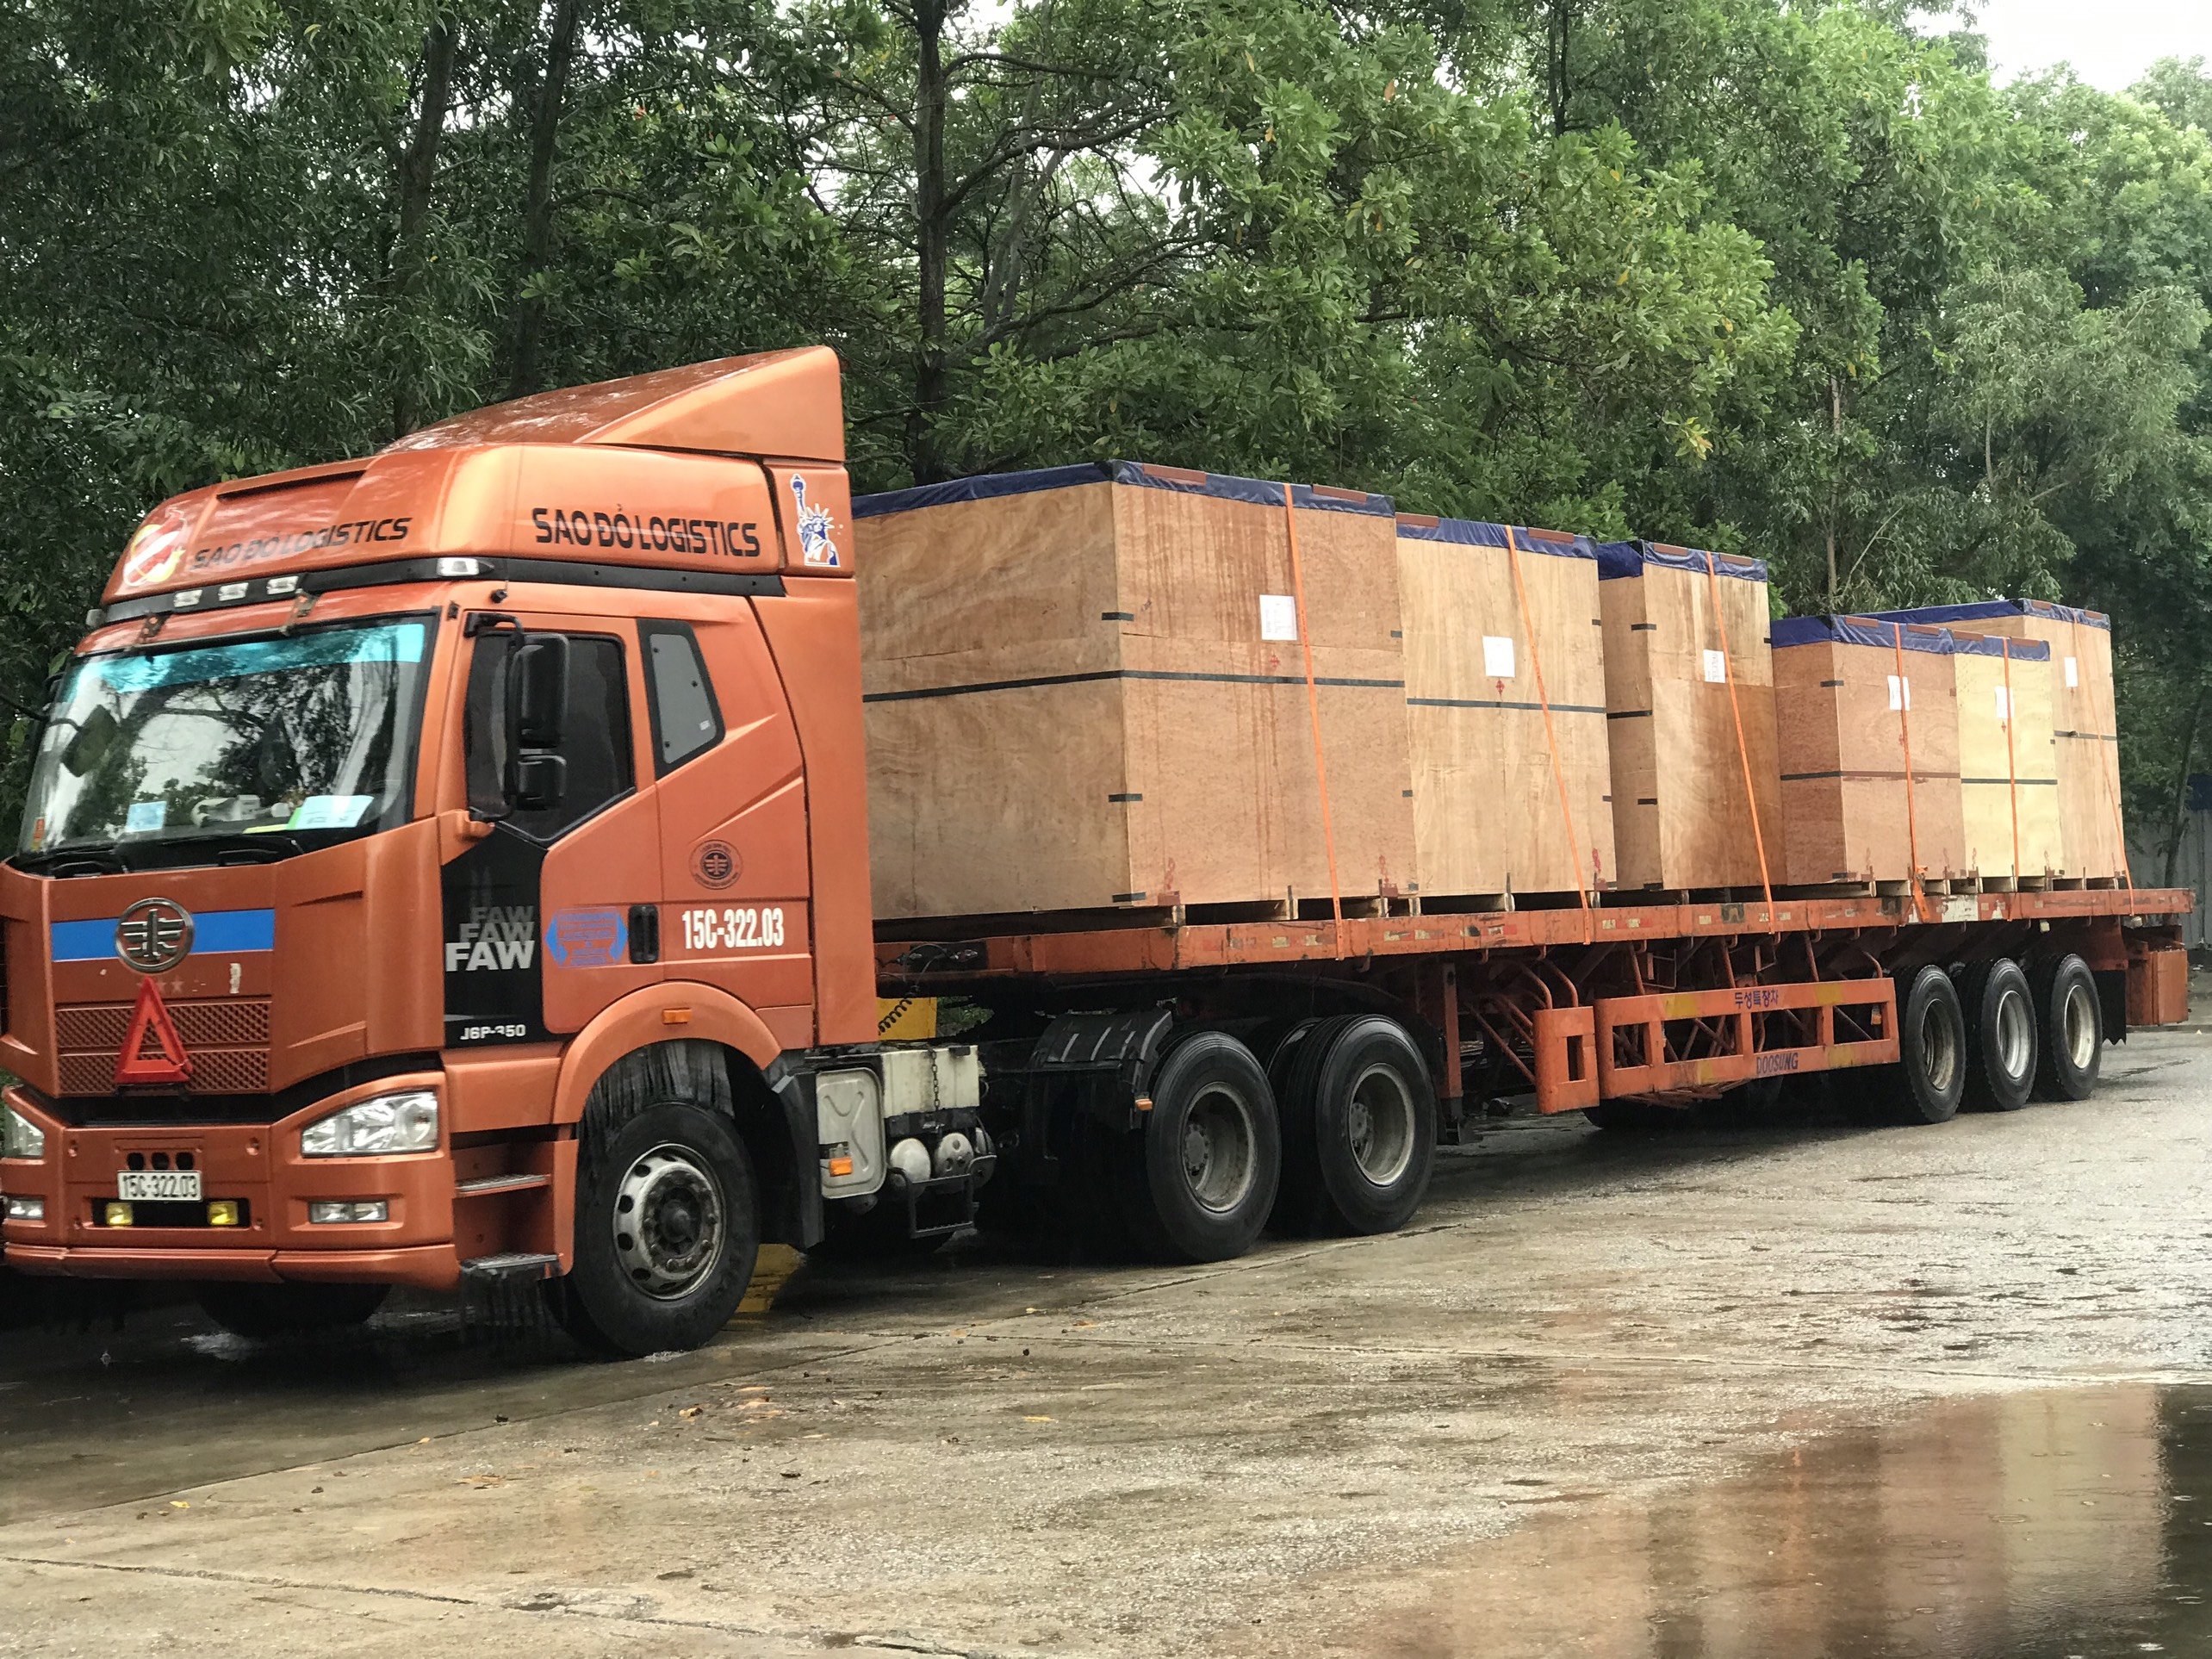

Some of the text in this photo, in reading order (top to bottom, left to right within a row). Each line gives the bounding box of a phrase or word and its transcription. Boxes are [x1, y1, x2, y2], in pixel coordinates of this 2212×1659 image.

[190, 543, 243, 570] SAO
[281, 518, 413, 556] LOGISTICS
[531, 507, 592, 546] SAO
[634, 514, 760, 557] LOGISTICS
[459, 921, 535, 943] FAW
[469, 905, 534, 923] FAW
[681, 907, 785, 949] 15C-322.03
[445, 940, 535, 972] FAW
